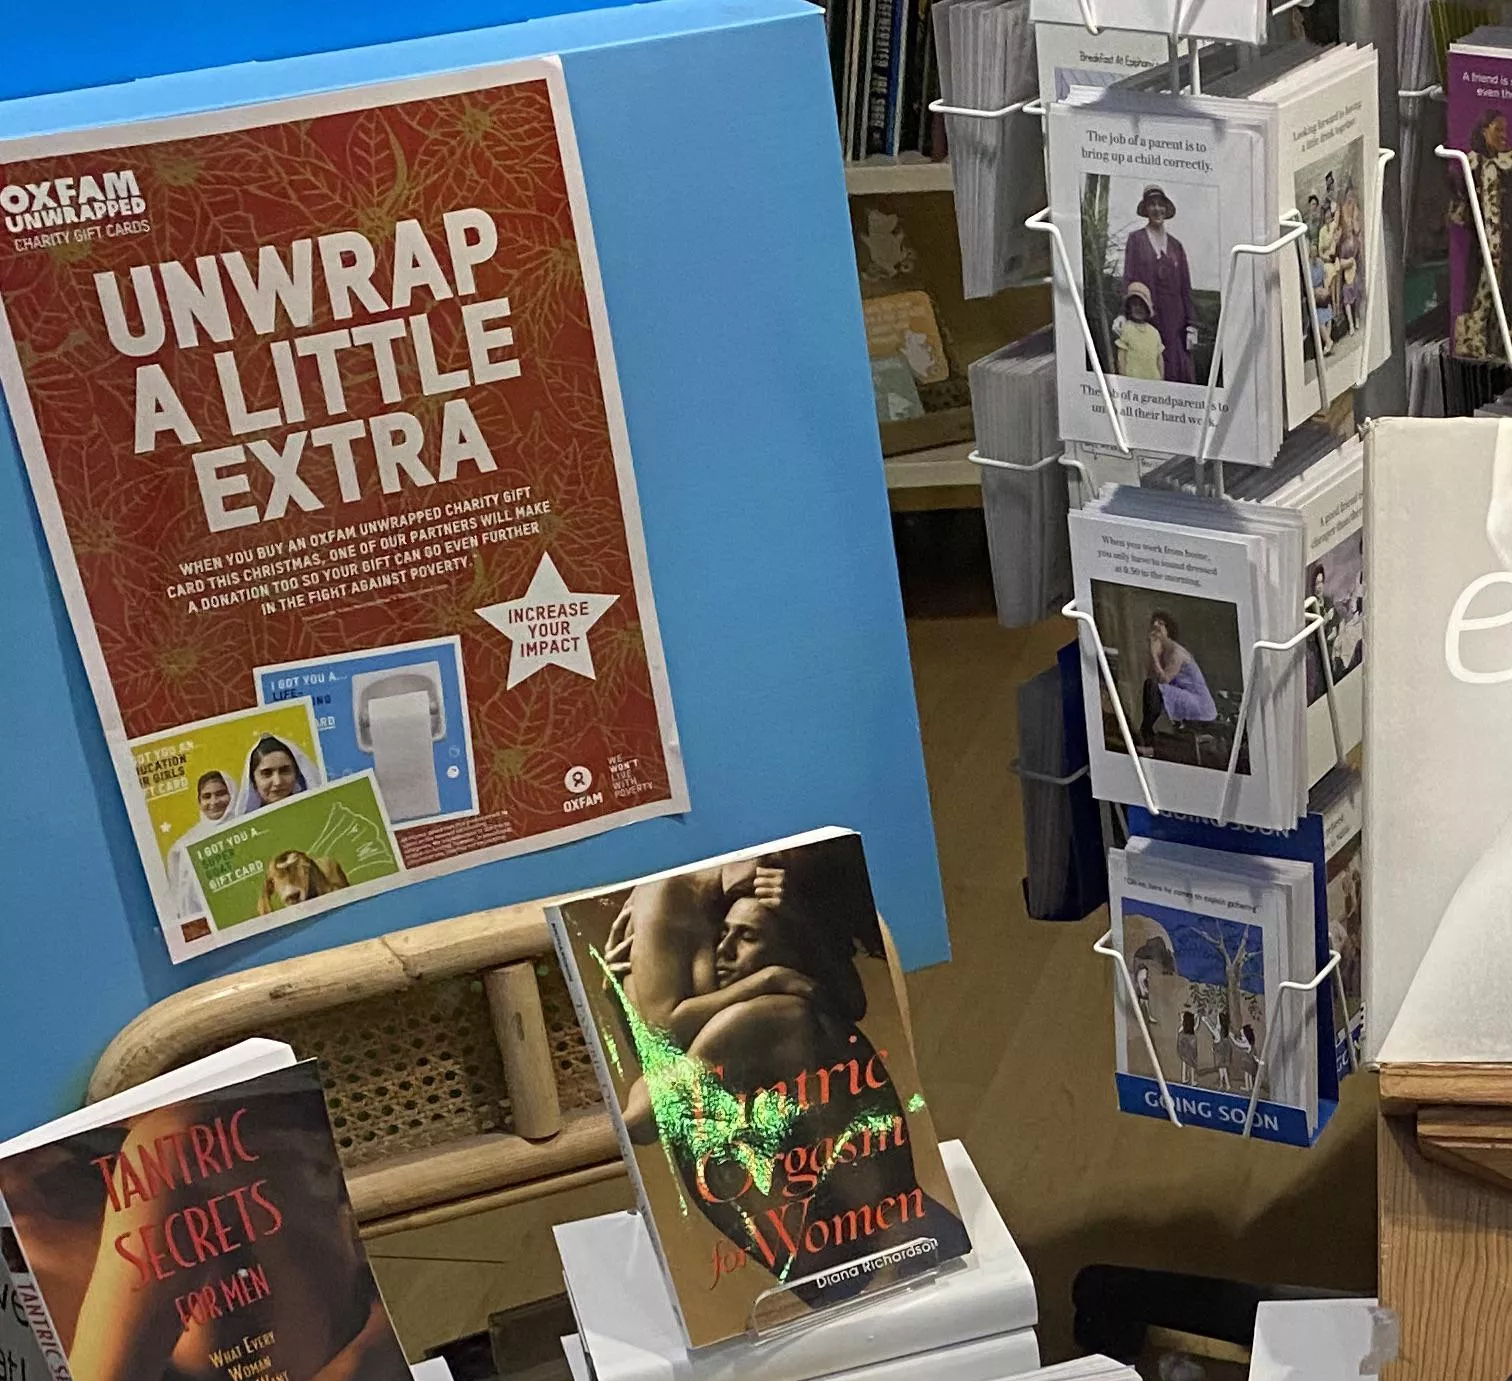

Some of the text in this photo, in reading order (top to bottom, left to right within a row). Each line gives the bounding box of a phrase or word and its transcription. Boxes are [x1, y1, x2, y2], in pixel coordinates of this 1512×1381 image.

[1081, 149, 1109, 162] bring
[1149, 140, 1182, 153] parent
[1, 169, 141, 214] OXFAM
[4, 197, 146, 233] UNWRAPPED
[105, 219, 151, 239] CARDS
[94, 207, 498, 358] UNWRAP
[134, 297, 521, 454] A LITTLE
[1162, 411, 1185, 423] hard
[192, 399, 498, 533] EXTRA
[360, 508, 442, 537] UNWRAPPED
[410, 517, 479, 543] PARTNERS
[508, 601, 590, 623] INCREASE
[528, 620, 571, 638] YOUR
[520, 637, 580, 658] IMPACT
[563, 793, 603, 813] OXFAM
[236, 861, 264, 879] CARD
[1145, 1091, 1279, 1131] GOING SOON
[91, 1107, 260, 1213] TANTRIC
[697, 1112, 909, 1203] Orgasm
[115, 1180, 284, 1288] SECRETS
[711, 1186, 926, 1290] for Women
[815, 1237, 938, 1290] Diana Richardson
[175, 1264, 272, 1330] FOR MEN
